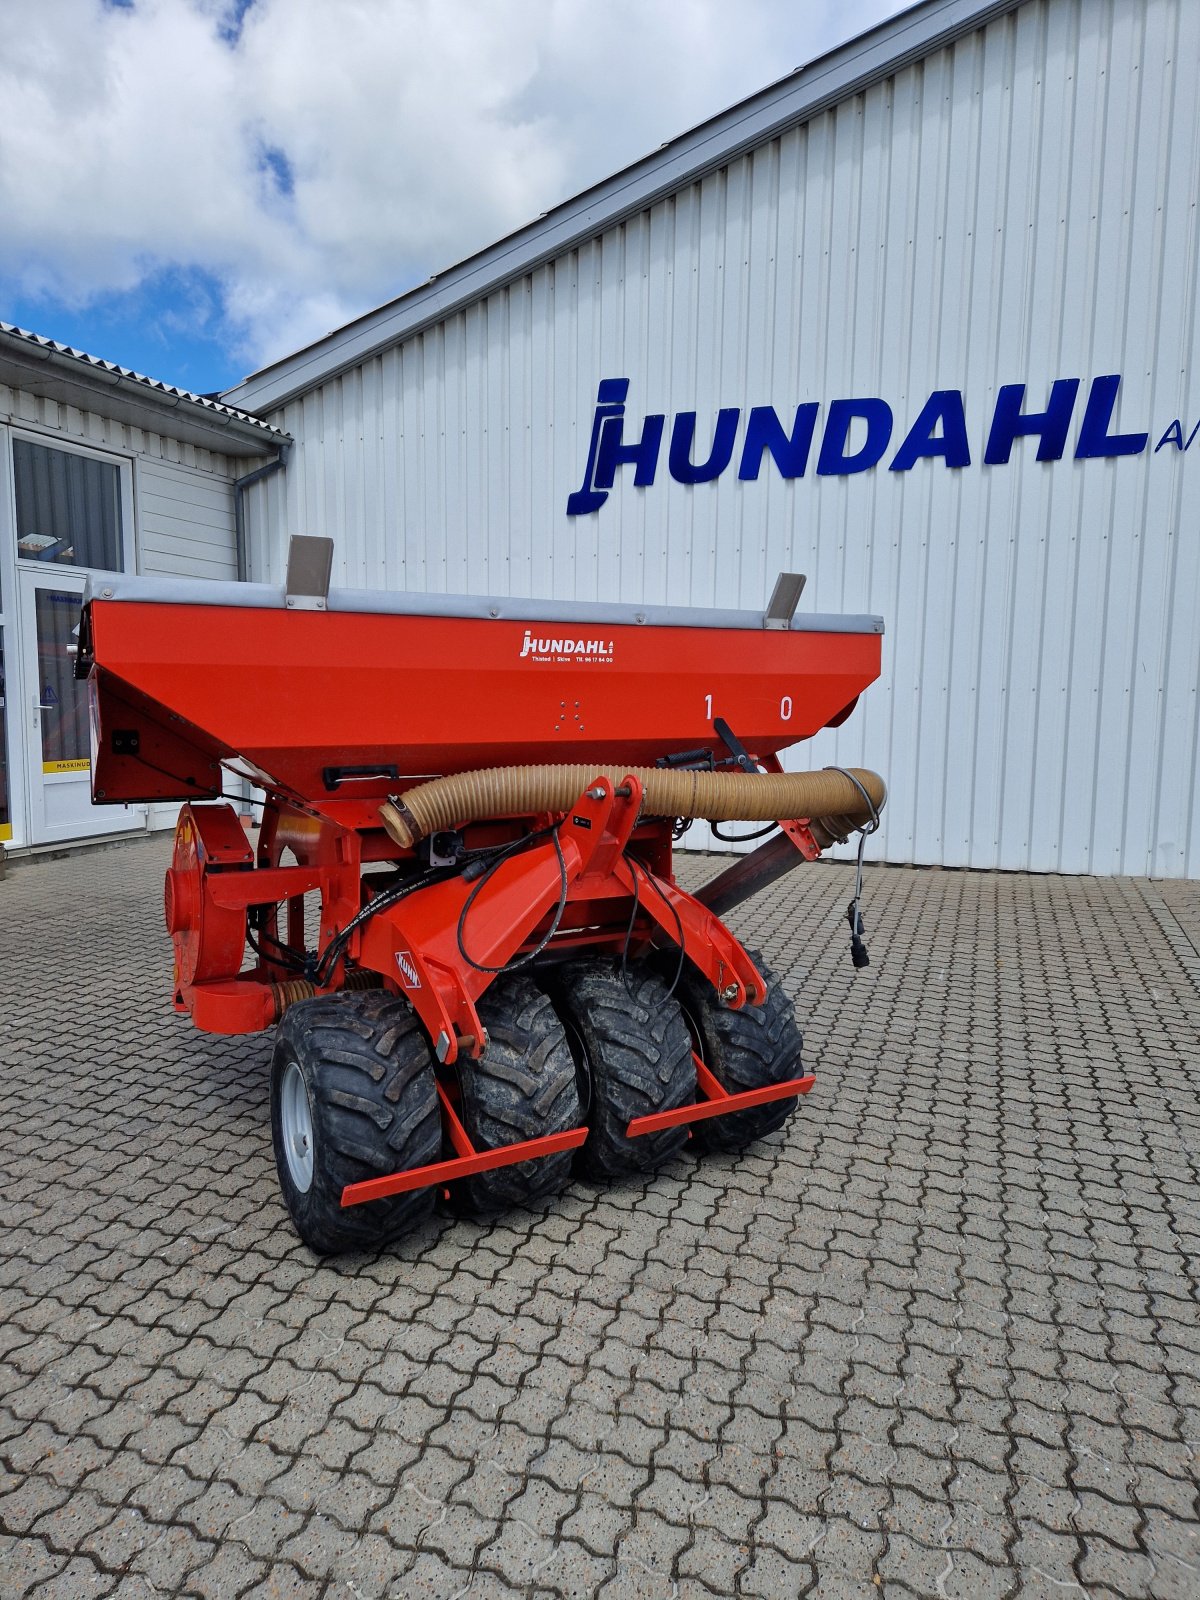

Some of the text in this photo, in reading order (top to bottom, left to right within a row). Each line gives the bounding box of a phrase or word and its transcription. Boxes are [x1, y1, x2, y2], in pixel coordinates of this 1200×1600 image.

[704, 694, 712, 720] 1
[780, 696, 792, 721] 0
[398, 953, 418, 987] KUHN
